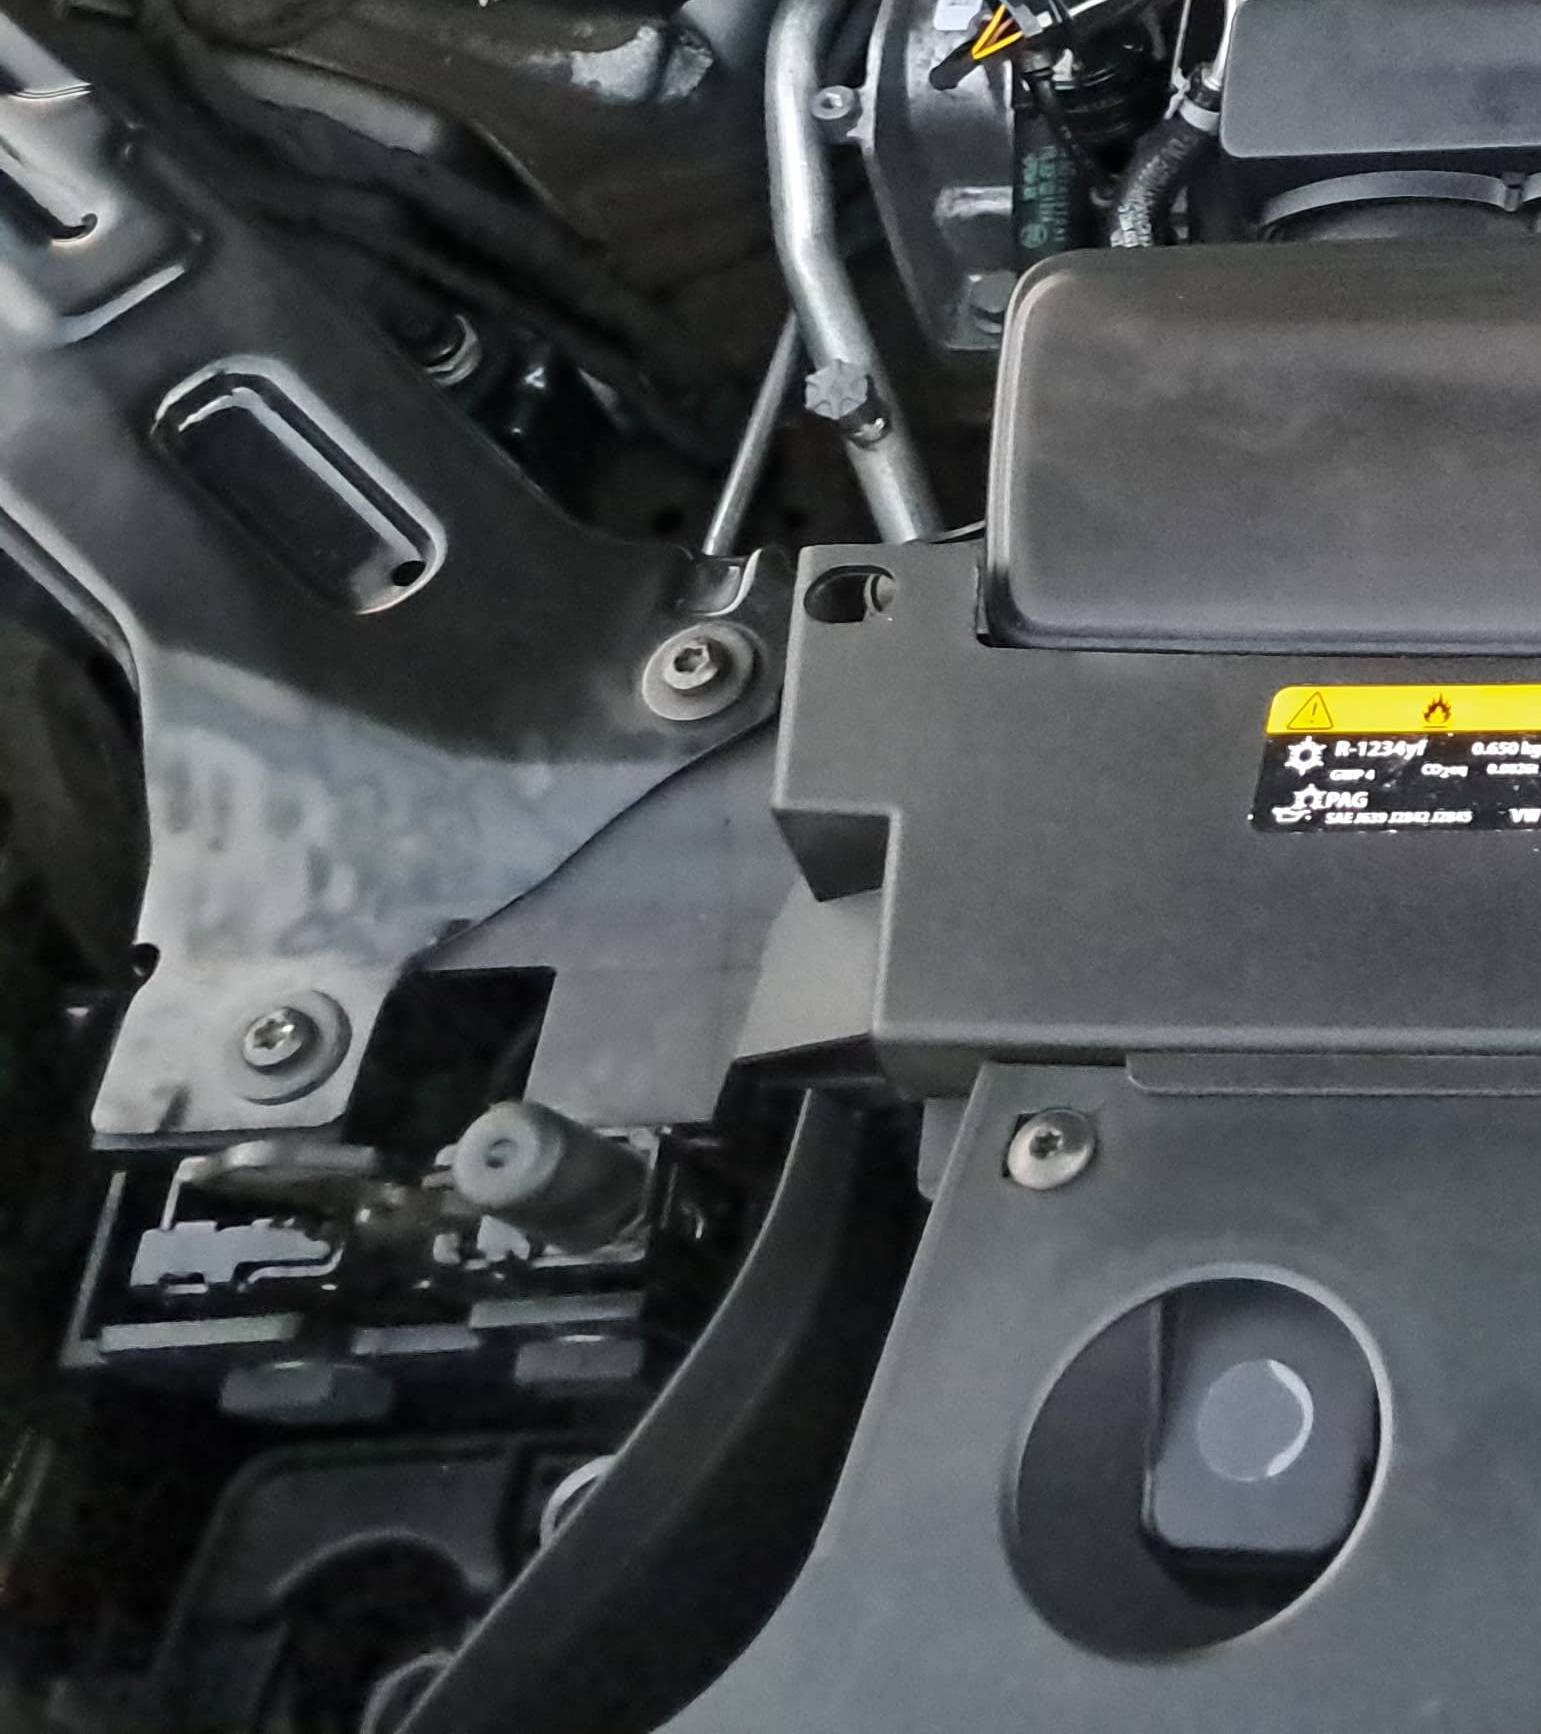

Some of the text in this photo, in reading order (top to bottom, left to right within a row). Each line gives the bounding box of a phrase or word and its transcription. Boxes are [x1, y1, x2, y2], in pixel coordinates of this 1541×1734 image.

[1335, 739, 1428, 760] R-1234yf
[1471, 742, 1519, 756] 0.650
[1327, 791, 1369, 808] PAG
[1509, 808, 1541, 823] VW
